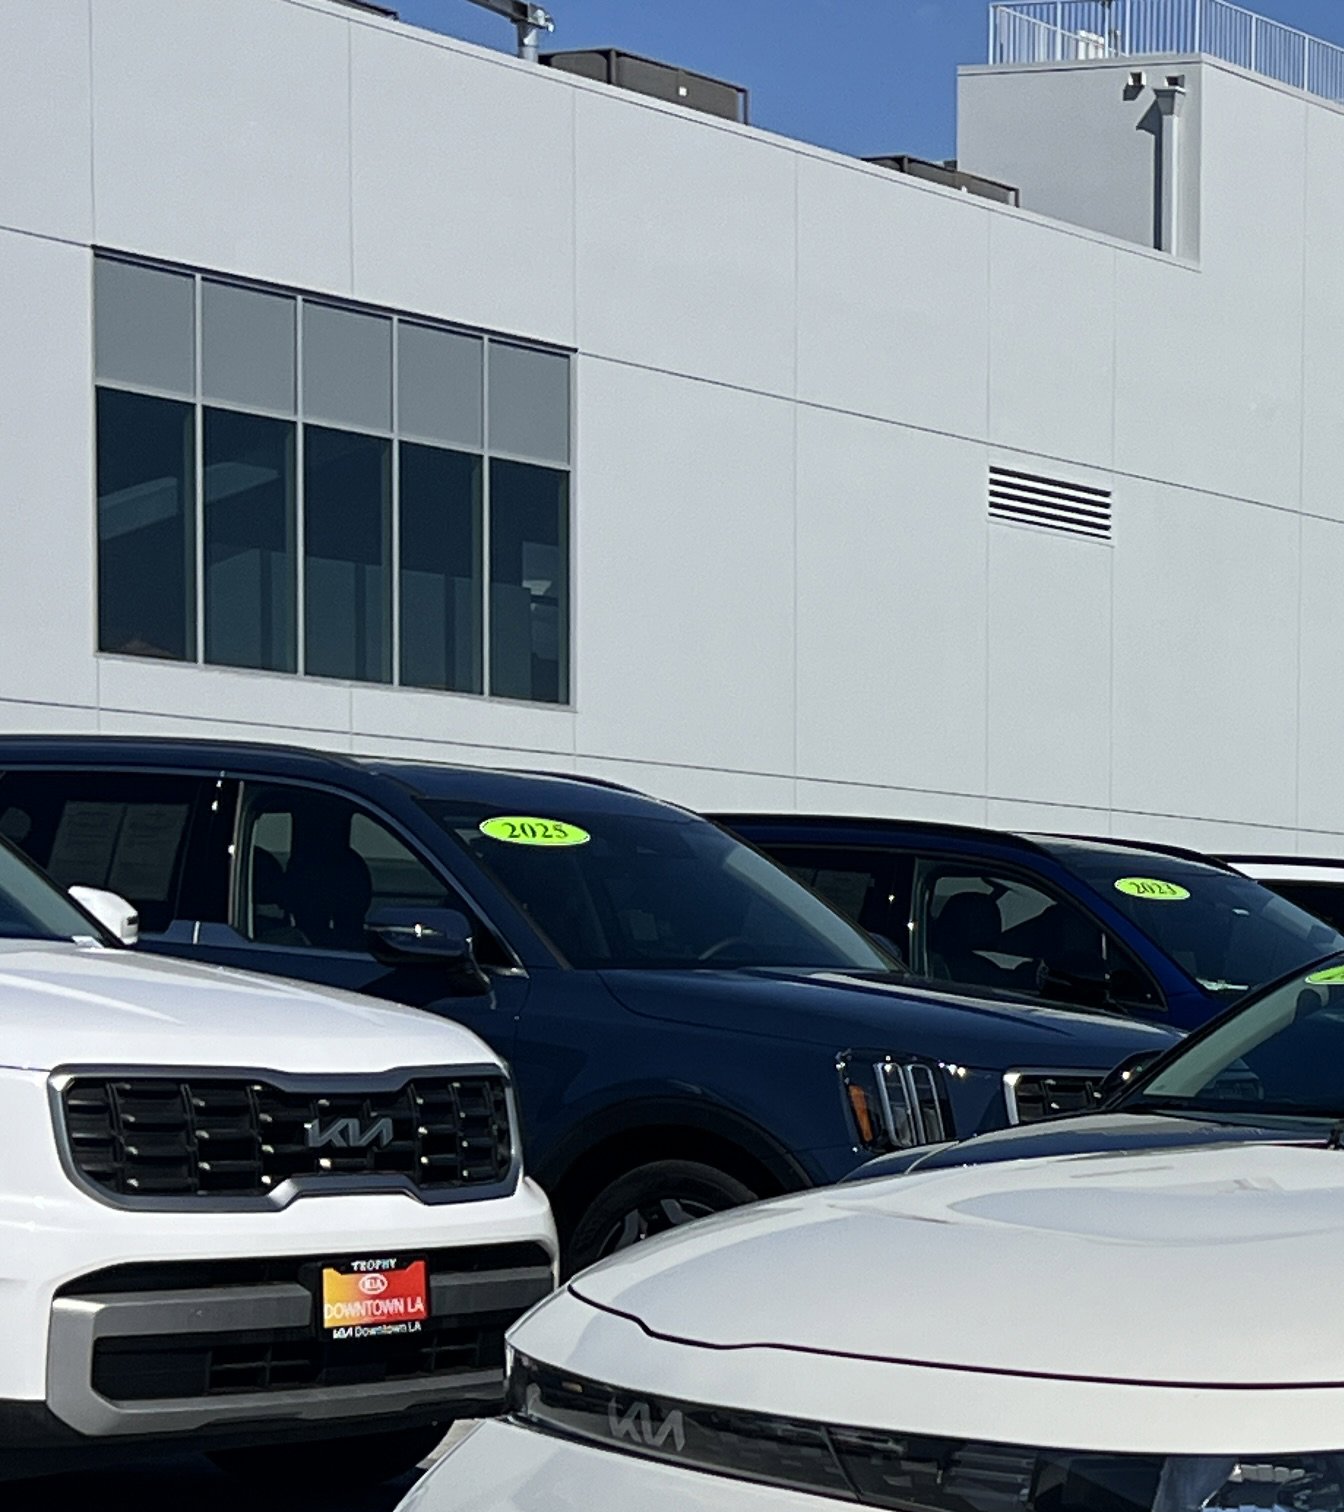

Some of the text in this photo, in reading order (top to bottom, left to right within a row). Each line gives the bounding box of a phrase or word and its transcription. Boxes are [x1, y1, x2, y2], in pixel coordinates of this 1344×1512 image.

[501, 822, 568, 839] 2025
[350, 1258, 397, 1272] TROPHY
[325, 1297, 424, 1319] DOWNTOWN LA
[408, 1321, 422, 1332] LA
